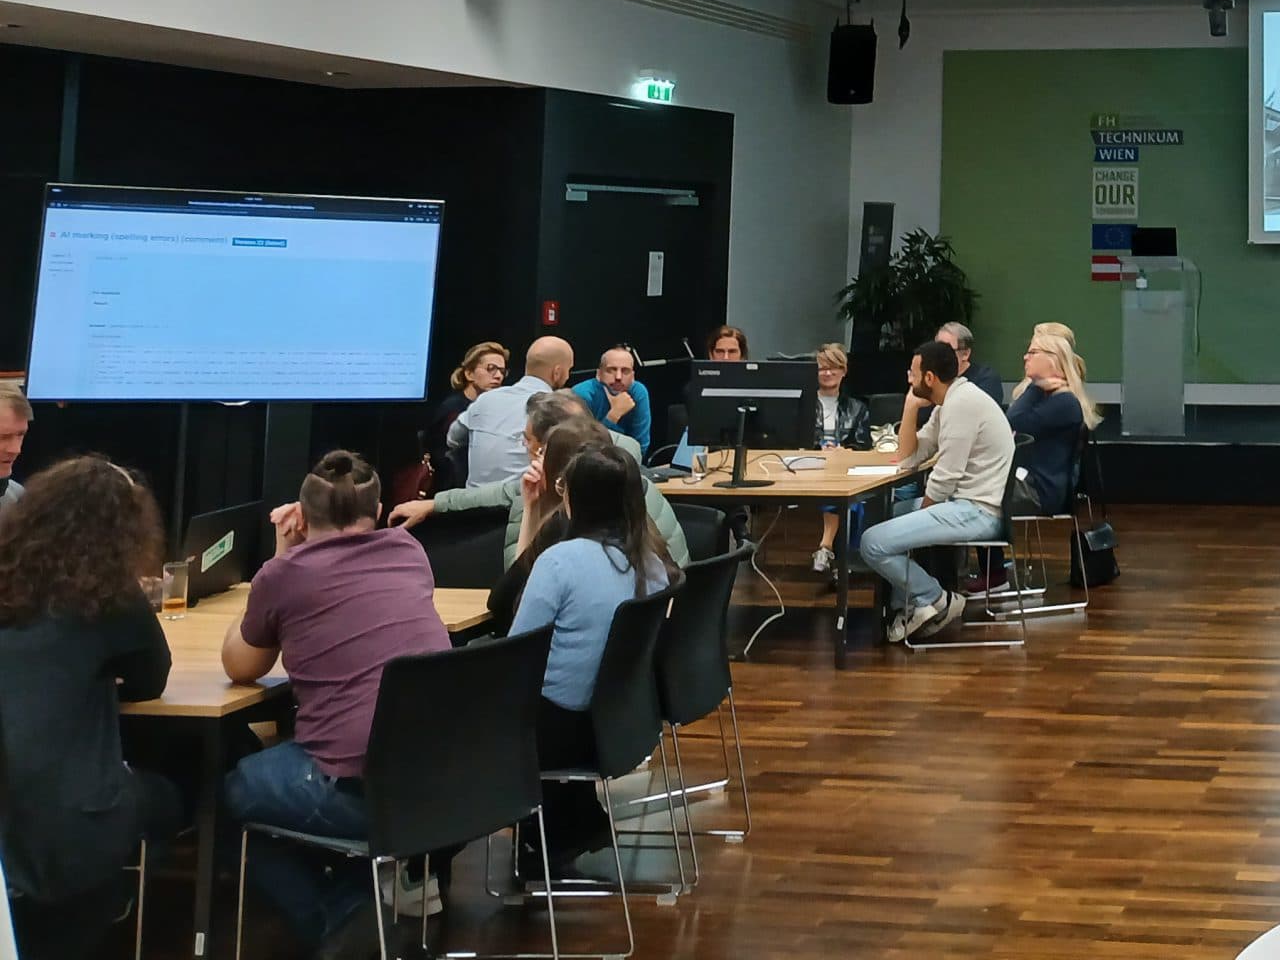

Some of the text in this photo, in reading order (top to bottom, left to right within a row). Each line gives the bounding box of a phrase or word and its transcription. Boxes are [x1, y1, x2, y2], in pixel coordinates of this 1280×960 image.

[1098, 116, 1116, 127] FH
[1099, 132, 1179, 144] TECHNIKUM
[1100, 149, 1135, 160] WIEN
[1095, 170, 1136, 182] CHANGE
[1095, 184, 1135, 206] OUR
